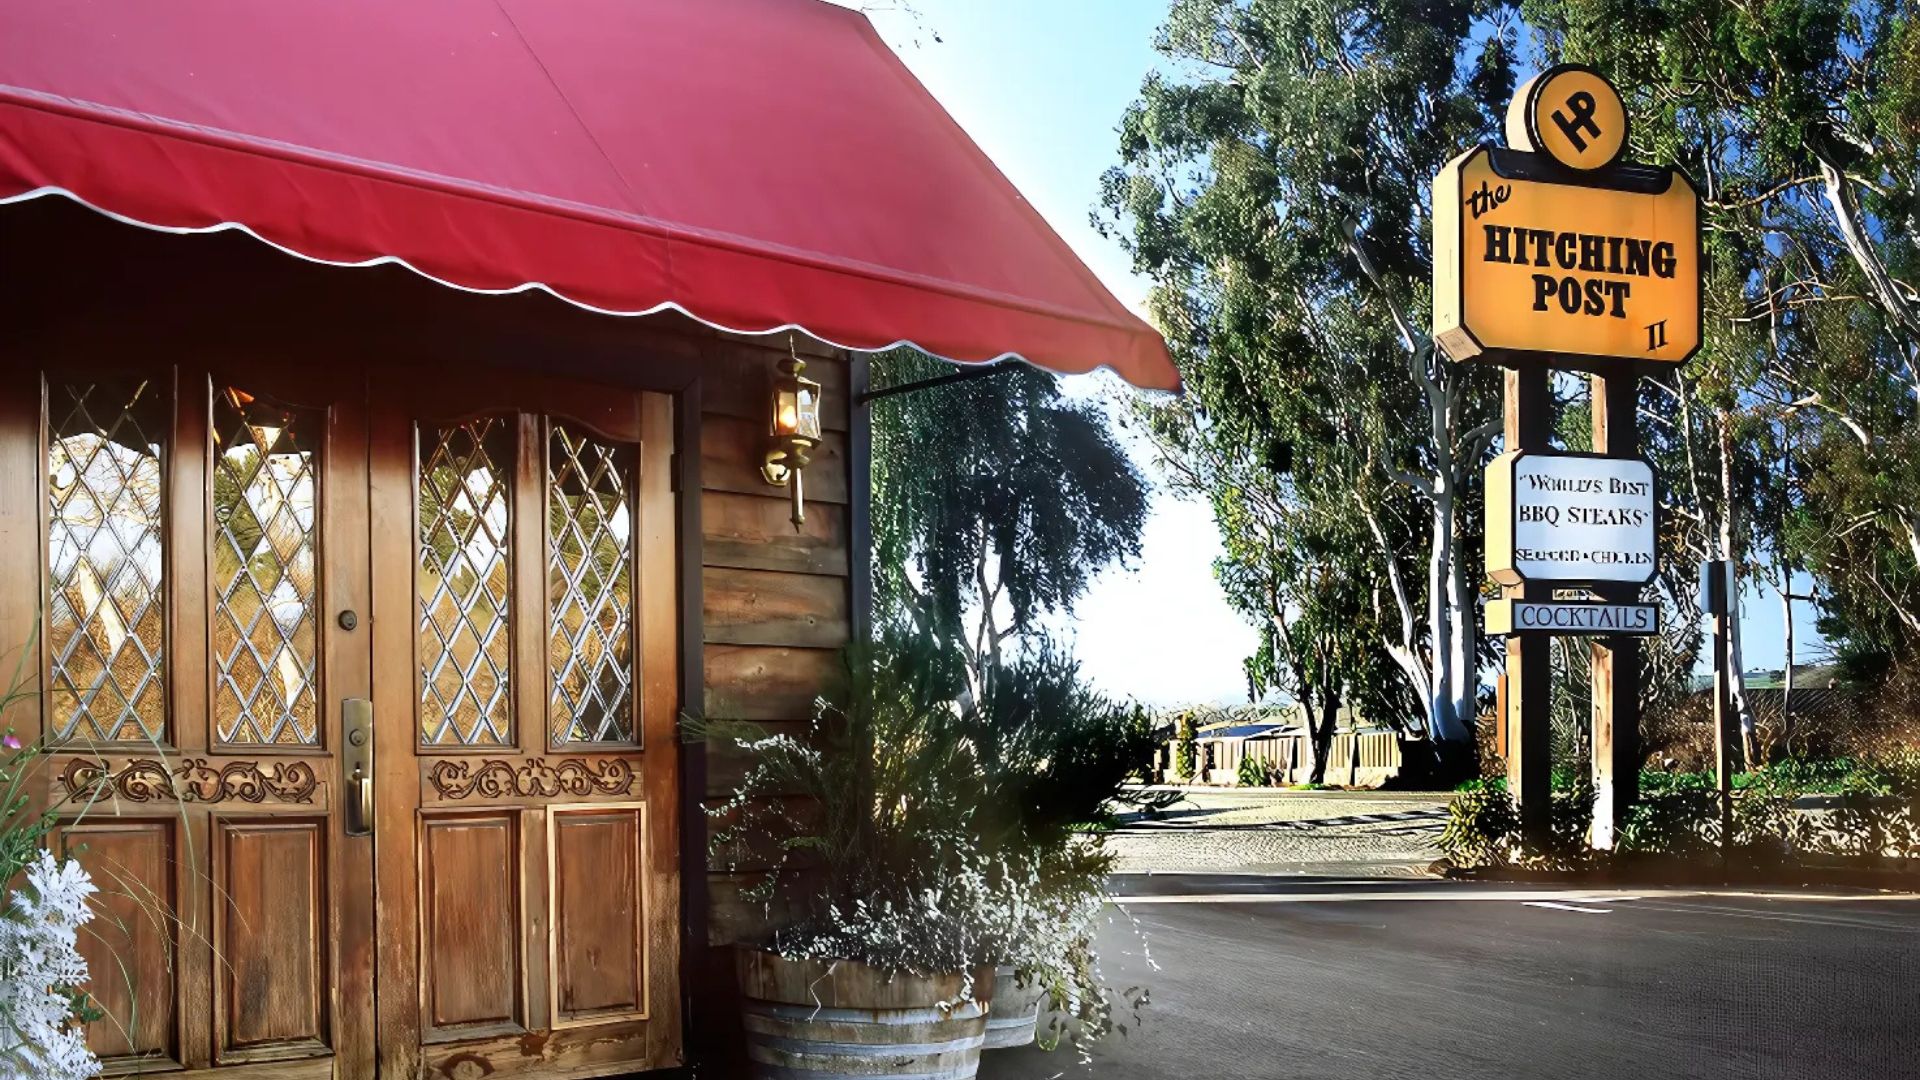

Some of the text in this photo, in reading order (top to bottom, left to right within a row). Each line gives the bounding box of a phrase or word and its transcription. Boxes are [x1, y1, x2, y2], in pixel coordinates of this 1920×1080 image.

[1465, 181, 1512, 219] the
[1483, 224, 1677, 279] HITCHING
[1532, 274, 1631, 318] POST
[1643, 319, 1669, 351] II
[1519, 505, 1560, 527] BBQ
[1521, 605, 1648, 629] COCKTAILS
